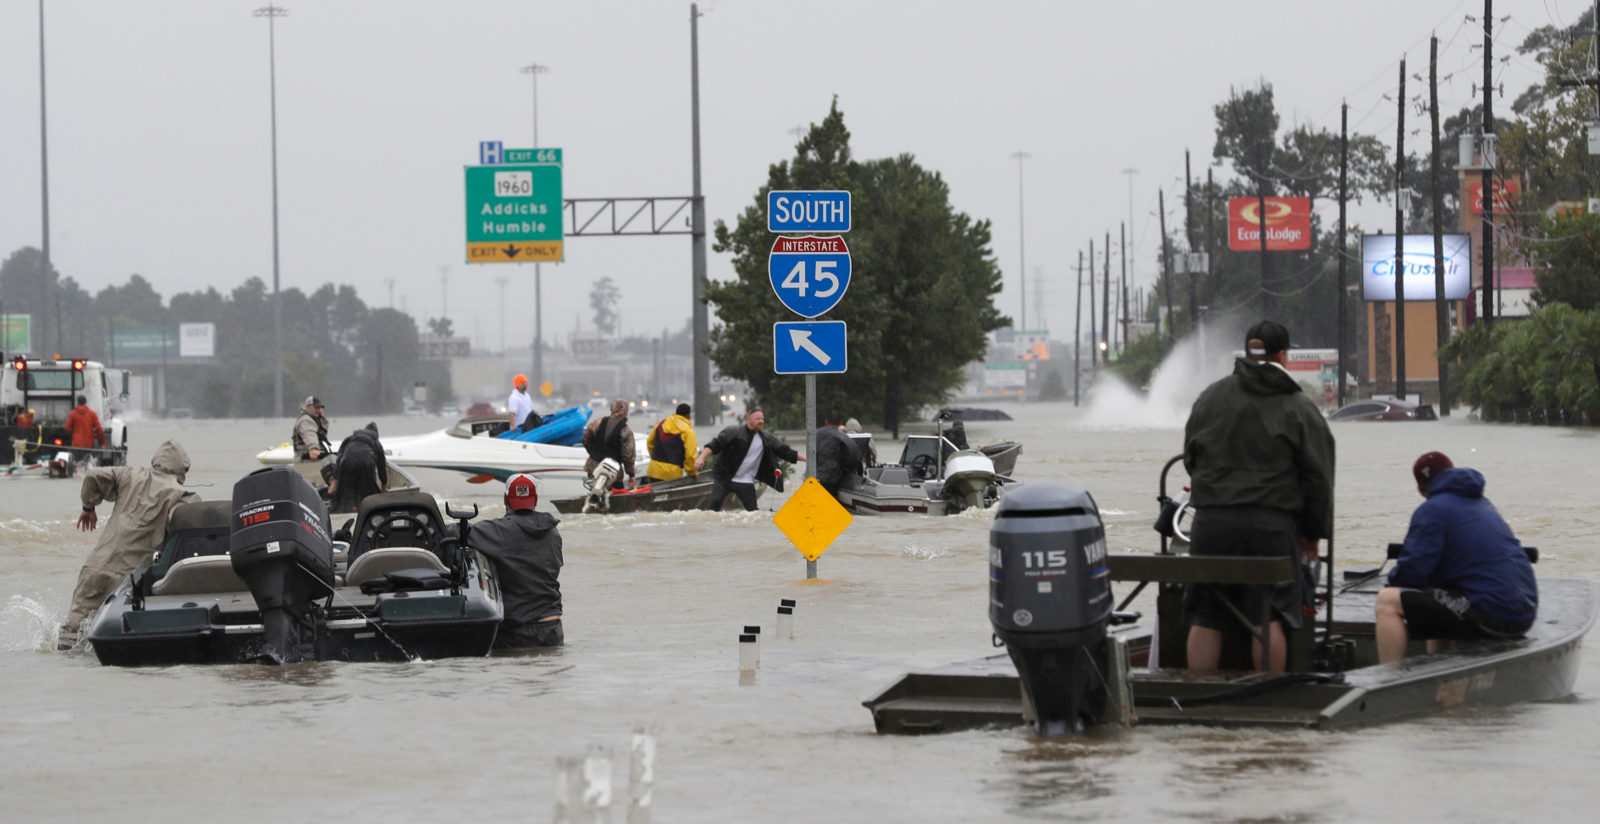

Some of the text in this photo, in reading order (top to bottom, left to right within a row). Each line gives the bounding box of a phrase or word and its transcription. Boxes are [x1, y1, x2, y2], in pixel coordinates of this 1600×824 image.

[509, 150, 556, 162] EXIT 66
[497, 180, 530, 194] 1960
[481, 202, 548, 215] Addicks
[775, 197, 844, 223] SOUTH
[483, 221, 546, 234] Humble
[471, 246, 558, 258] EXIT ONLY
[782, 241, 839, 252] INTERSTATE
[781, 260, 840, 298] 45
[240, 504, 275, 518] TRACKER
[242, 511, 270, 527] 115
[1022, 550, 1067, 568] 115
